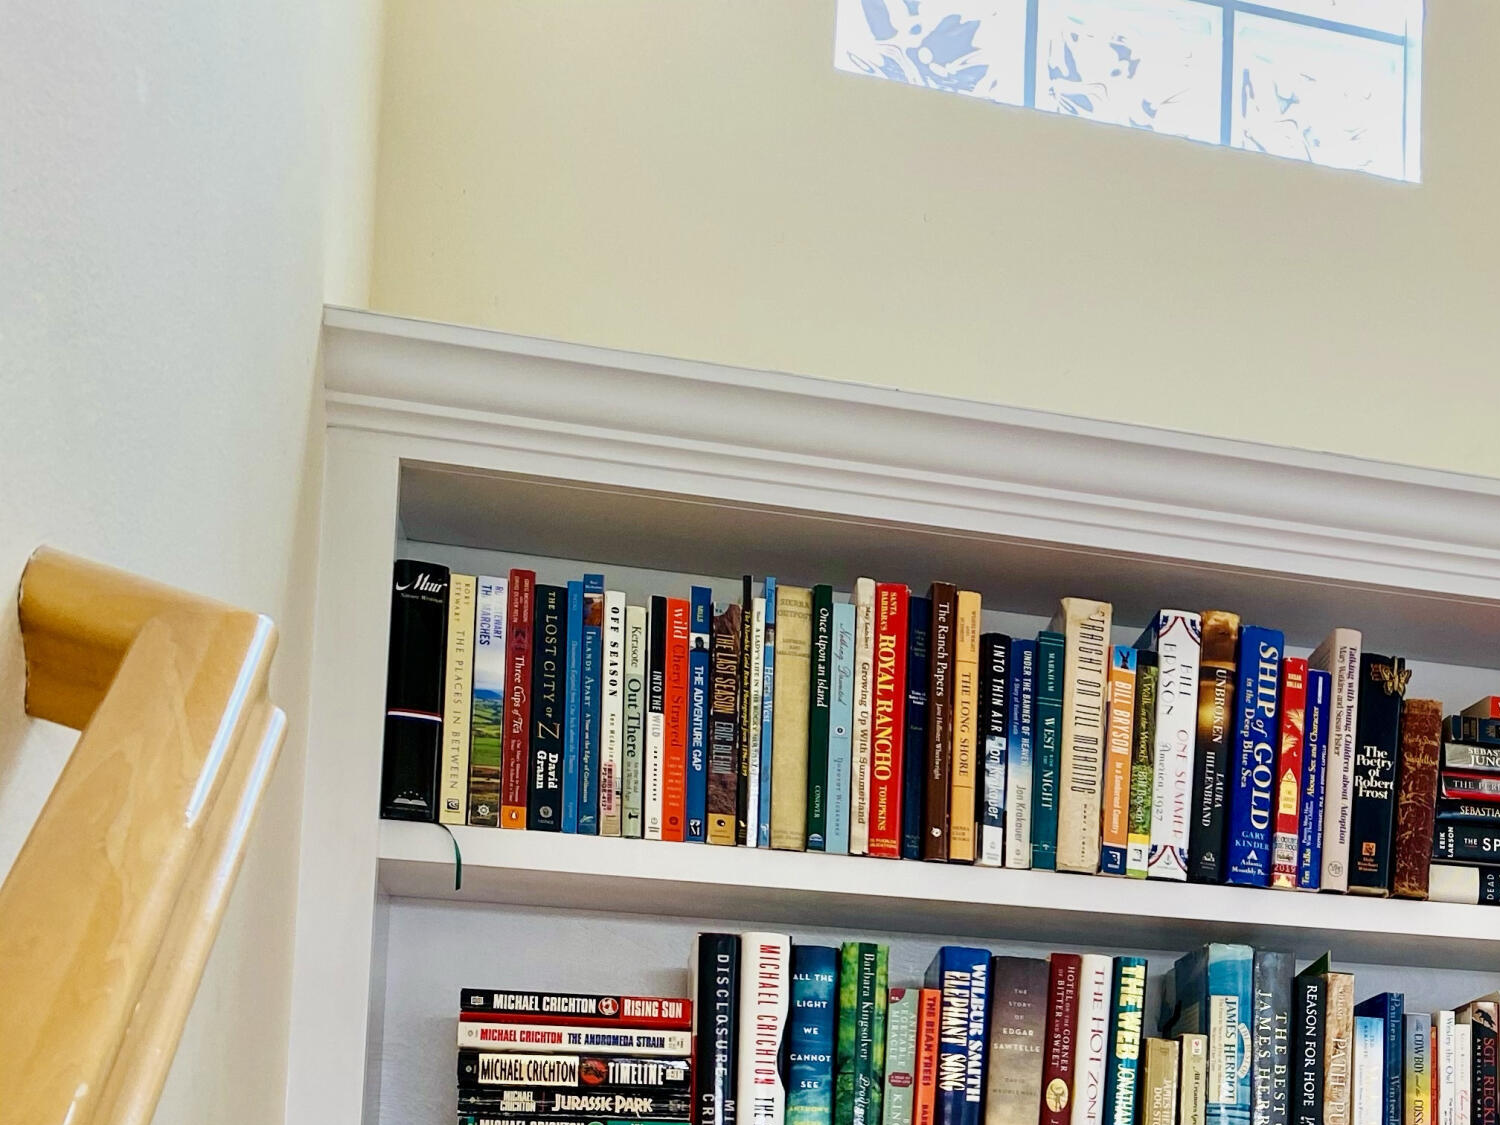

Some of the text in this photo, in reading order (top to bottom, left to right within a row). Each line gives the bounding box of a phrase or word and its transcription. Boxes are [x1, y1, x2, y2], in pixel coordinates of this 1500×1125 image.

[396, 572, 447, 593] Muir
[548, 591, 556, 610] THE
[545, 614, 558, 656] LOST
[609, 606, 620, 697] OFF SEASON
[816, 607, 829, 708] Once Upon an Island
[544, 661, 556, 700] CITY
[990, 644, 1005, 733] INTO THIN AIR
[450, 631, 465, 789] THE PLACES IN BETWEEN
[626, 678, 641, 758] Out There
[692, 666, 704, 771] THE ADVENTURE GAP
[1111, 680, 1132, 755] BILL BRYSON
[536, 721, 560, 739] Z
[1251, 641, 1279, 829] SHIP of GOLD
[1357, 755, 1394, 770] Poetry
[1363, 746, 1388, 759] The
[536, 750, 547, 789] Grann
[548, 752, 559, 789] David
[1368, 767, 1380, 778] of
[1354, 776, 1394, 792] Robert
[1358, 788, 1389, 799] Frost
[1464, 838, 1478, 846] THE
[493, 994, 596, 1013] MICHAEL CRICHTON
[623, 999, 683, 1018] RISING SUN
[754, 944, 780, 1085] MICHAEL CRICHTON
[797, 1000, 827, 1008] LIGHT
[715, 954, 730, 1077] DISCLOSURE
[480, 1028, 562, 1043] MICHAEL CRICHTON
[568, 1033, 665, 1048] THE ANDROMEDA STRAIN
[1304, 985, 1318, 1107] REASON FOR HOPE
[481, 1058, 575, 1081] MICHAEL CRICHTON
[790, 1054, 831, 1062] CANNOT
[608, 1062, 663, 1085] TIMELINE
[552, 1094, 653, 1118] JURASSIC PARK
